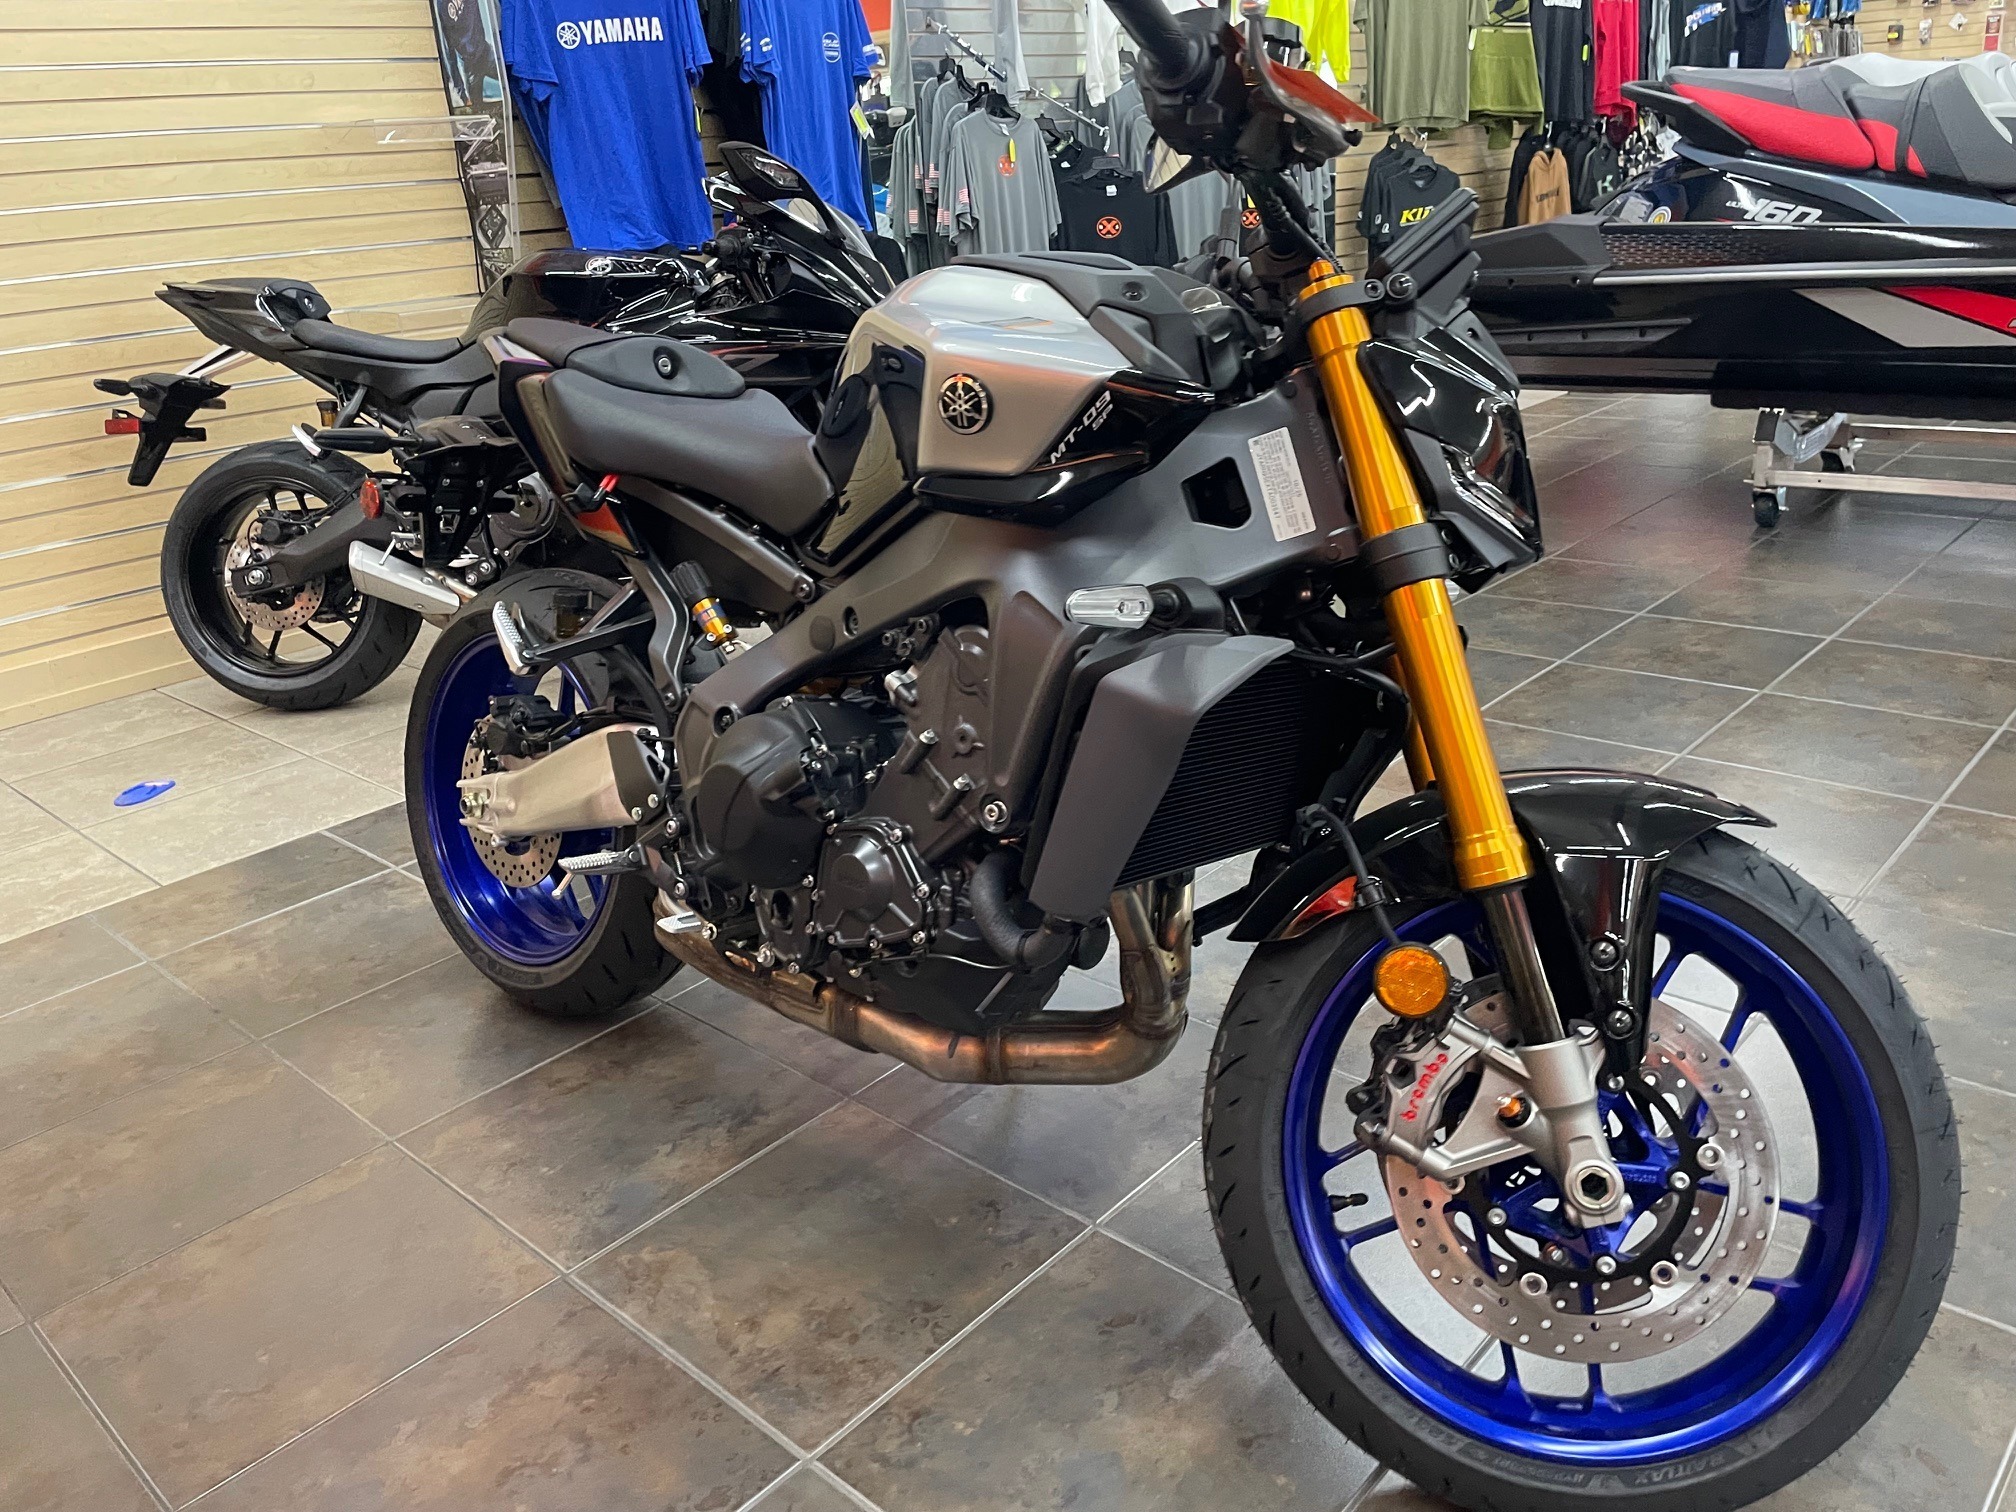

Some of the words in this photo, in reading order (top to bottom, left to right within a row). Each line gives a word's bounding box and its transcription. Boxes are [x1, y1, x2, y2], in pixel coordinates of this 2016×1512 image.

[578, 17, 664, 45] YAMAHA
[1050, 390, 1112, 464] MT-09
[1092, 403, 1114, 431] SP
[1400, 1053, 1448, 1122] brembo
